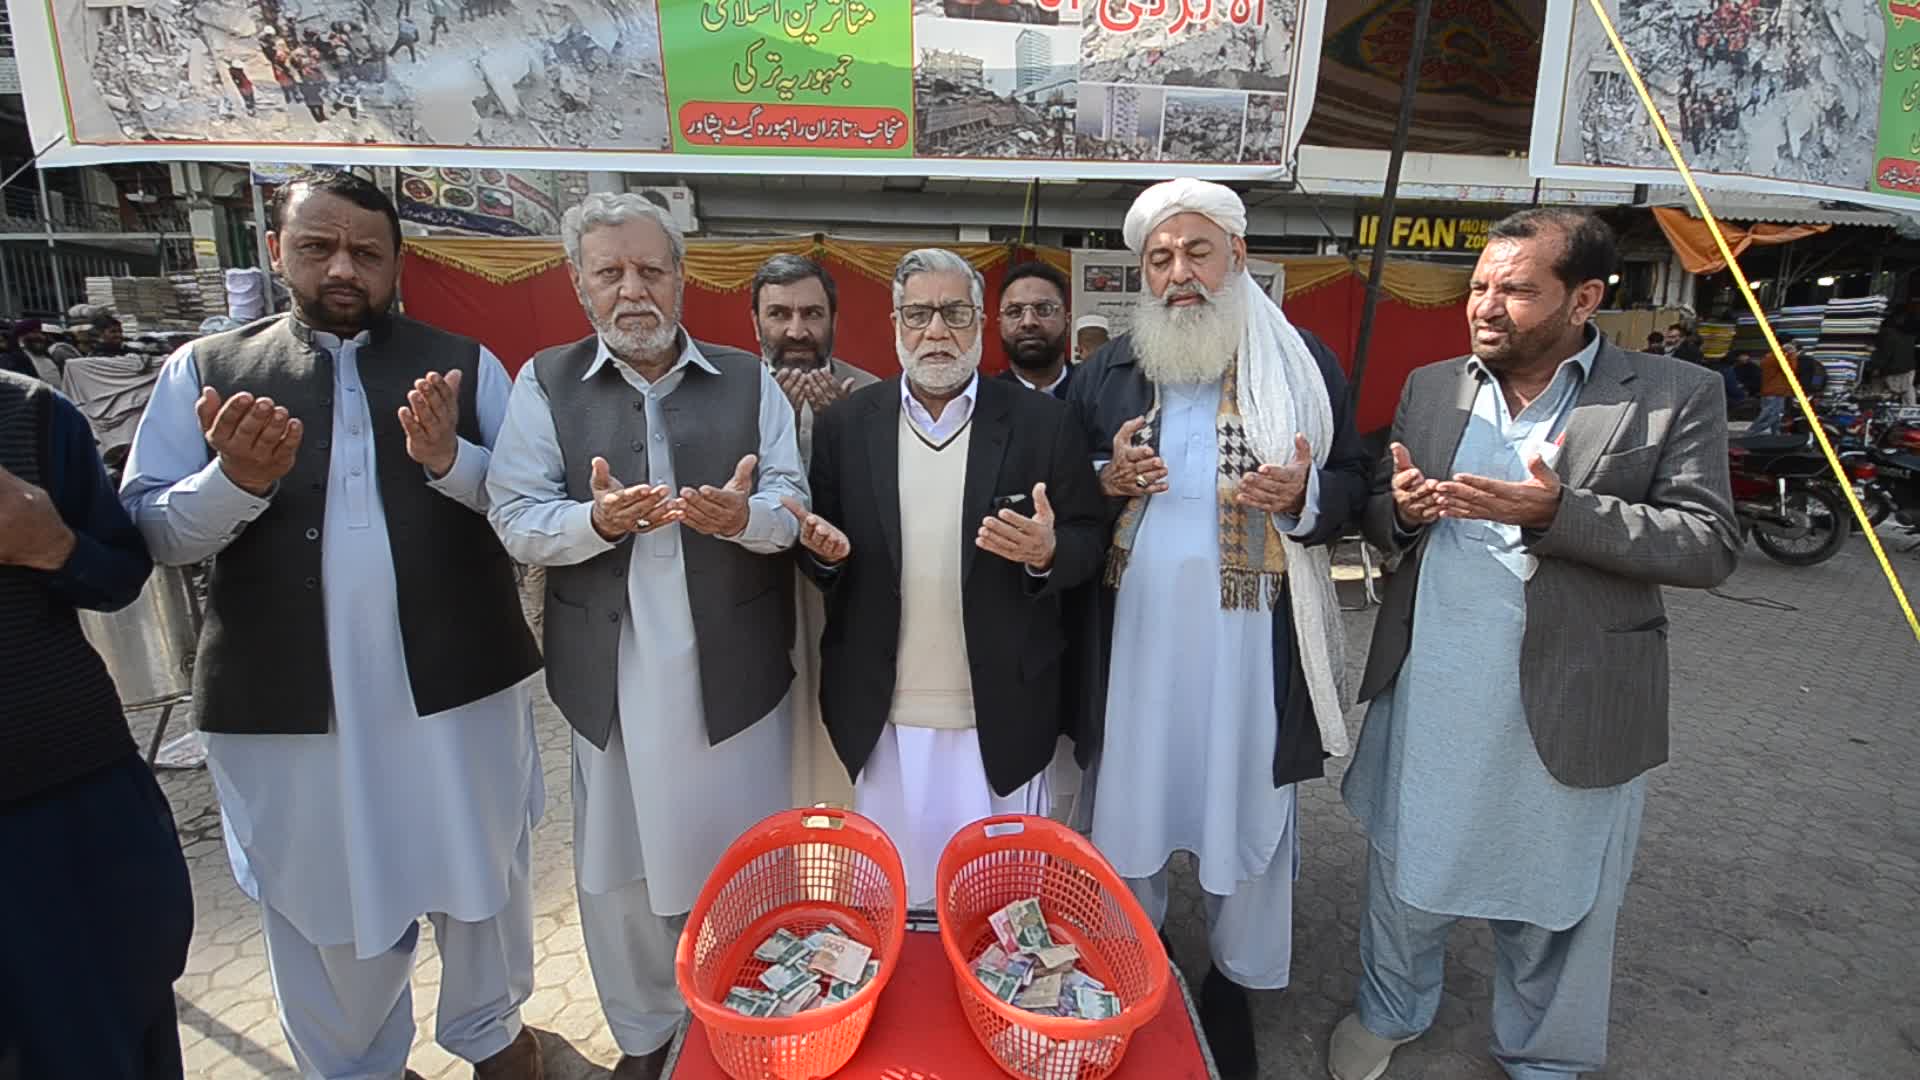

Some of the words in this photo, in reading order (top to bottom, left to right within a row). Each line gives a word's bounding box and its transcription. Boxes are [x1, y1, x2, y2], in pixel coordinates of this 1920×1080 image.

[733, 38, 783, 93] ترکی
[776, 55, 854, 99] جمہوریہ
[687, 113, 722, 143] پشاور
[723, 104, 765, 138] گیٹ
